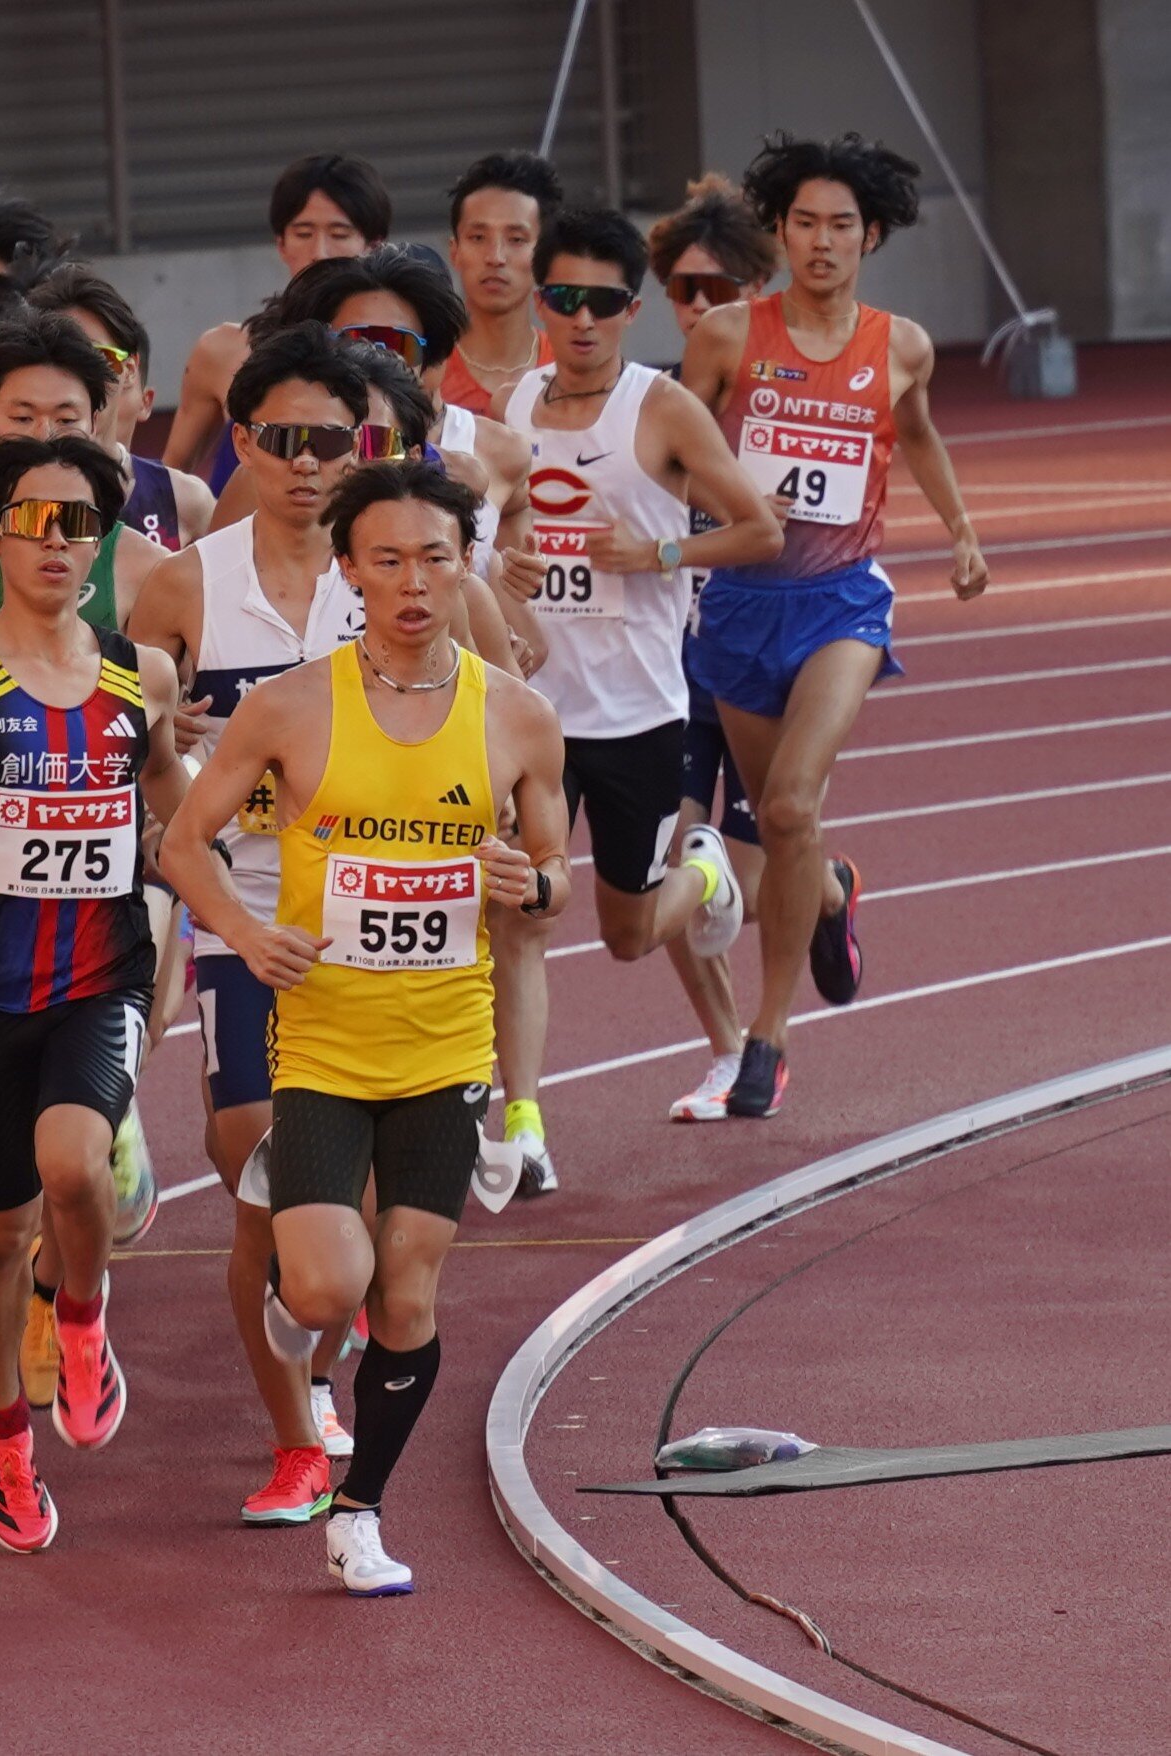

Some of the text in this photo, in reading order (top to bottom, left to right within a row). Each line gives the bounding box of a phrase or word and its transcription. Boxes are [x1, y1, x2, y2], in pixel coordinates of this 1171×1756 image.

[783, 397, 877, 424] NTT西日本
[778, 433, 862, 460] ヤマザキ
[776, 466, 827, 507] 49
[0, 752, 132, 785] 創価大学
[35, 800, 128, 824] ヤマザキ
[344, 817, 486, 847] LOGISTEED
[20, 838, 112, 881] 275
[372, 871, 470, 896] ヤマザキ
[360, 909, 448, 954] 559
